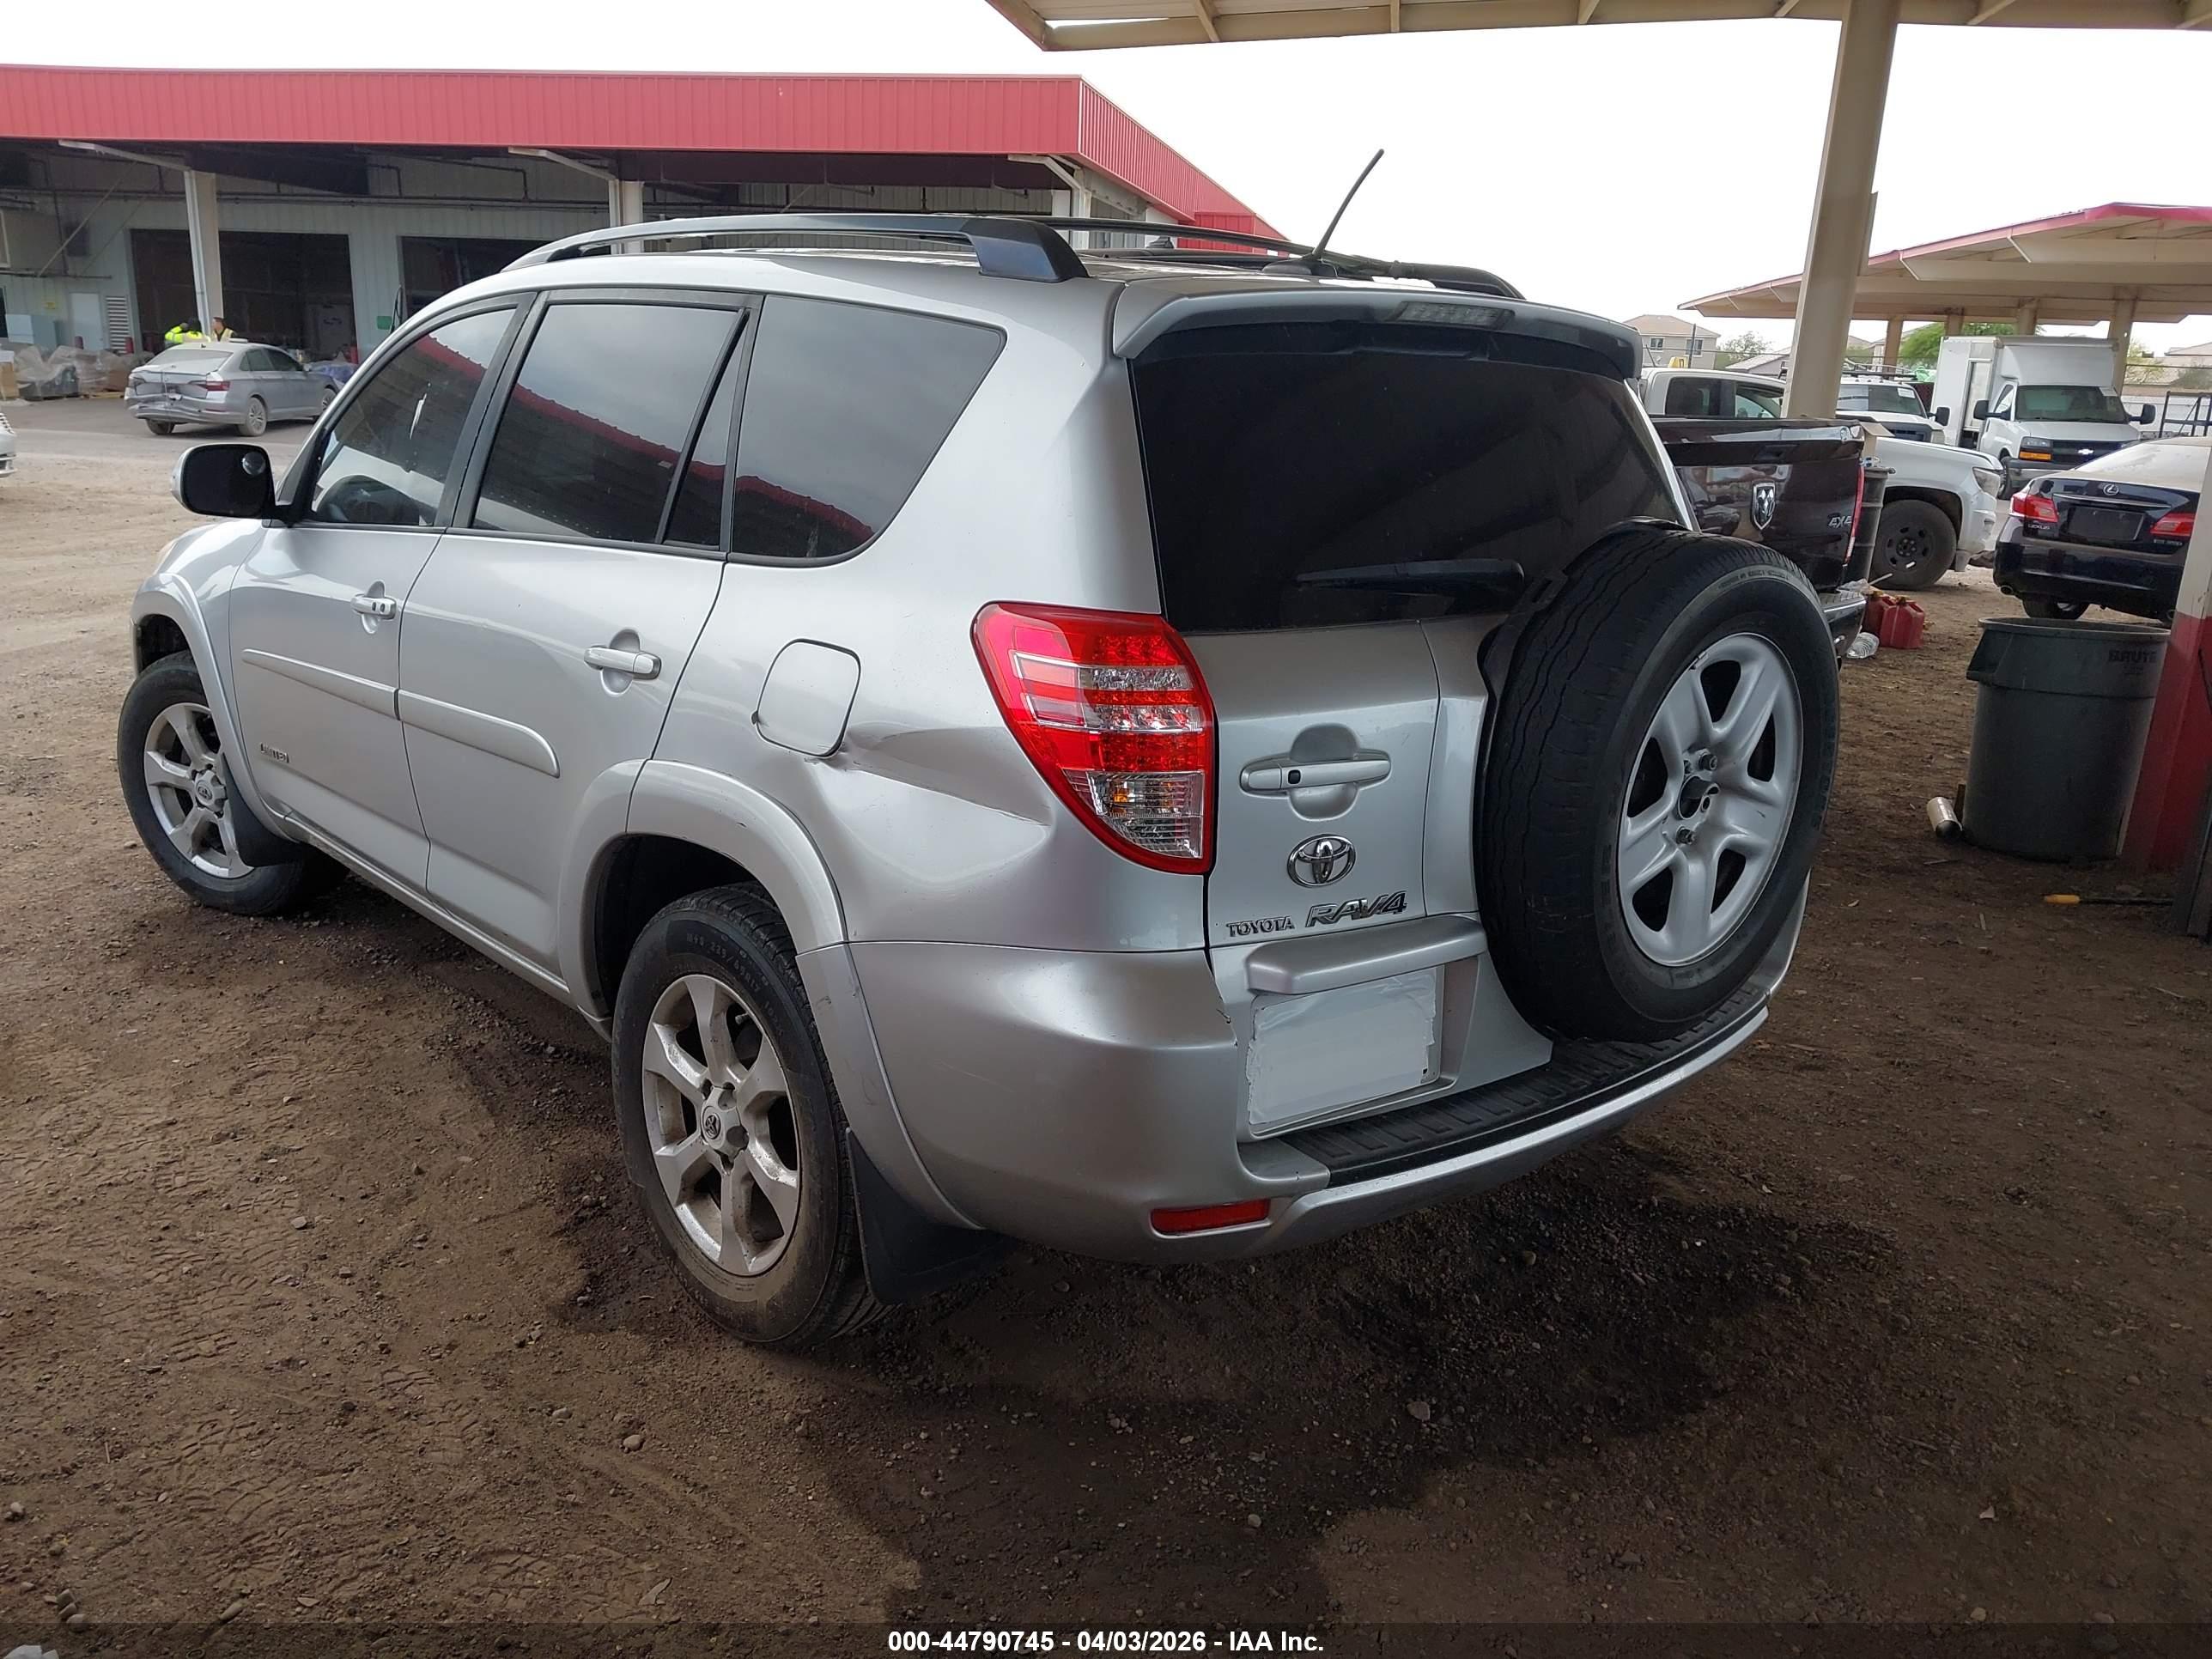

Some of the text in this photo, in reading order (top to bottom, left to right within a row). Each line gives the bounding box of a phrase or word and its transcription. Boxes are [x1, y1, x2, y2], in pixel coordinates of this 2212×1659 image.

[2108, 649, 2157, 664] BRUTE
[1227, 890, 1408, 938] TOYOTA RAV4
